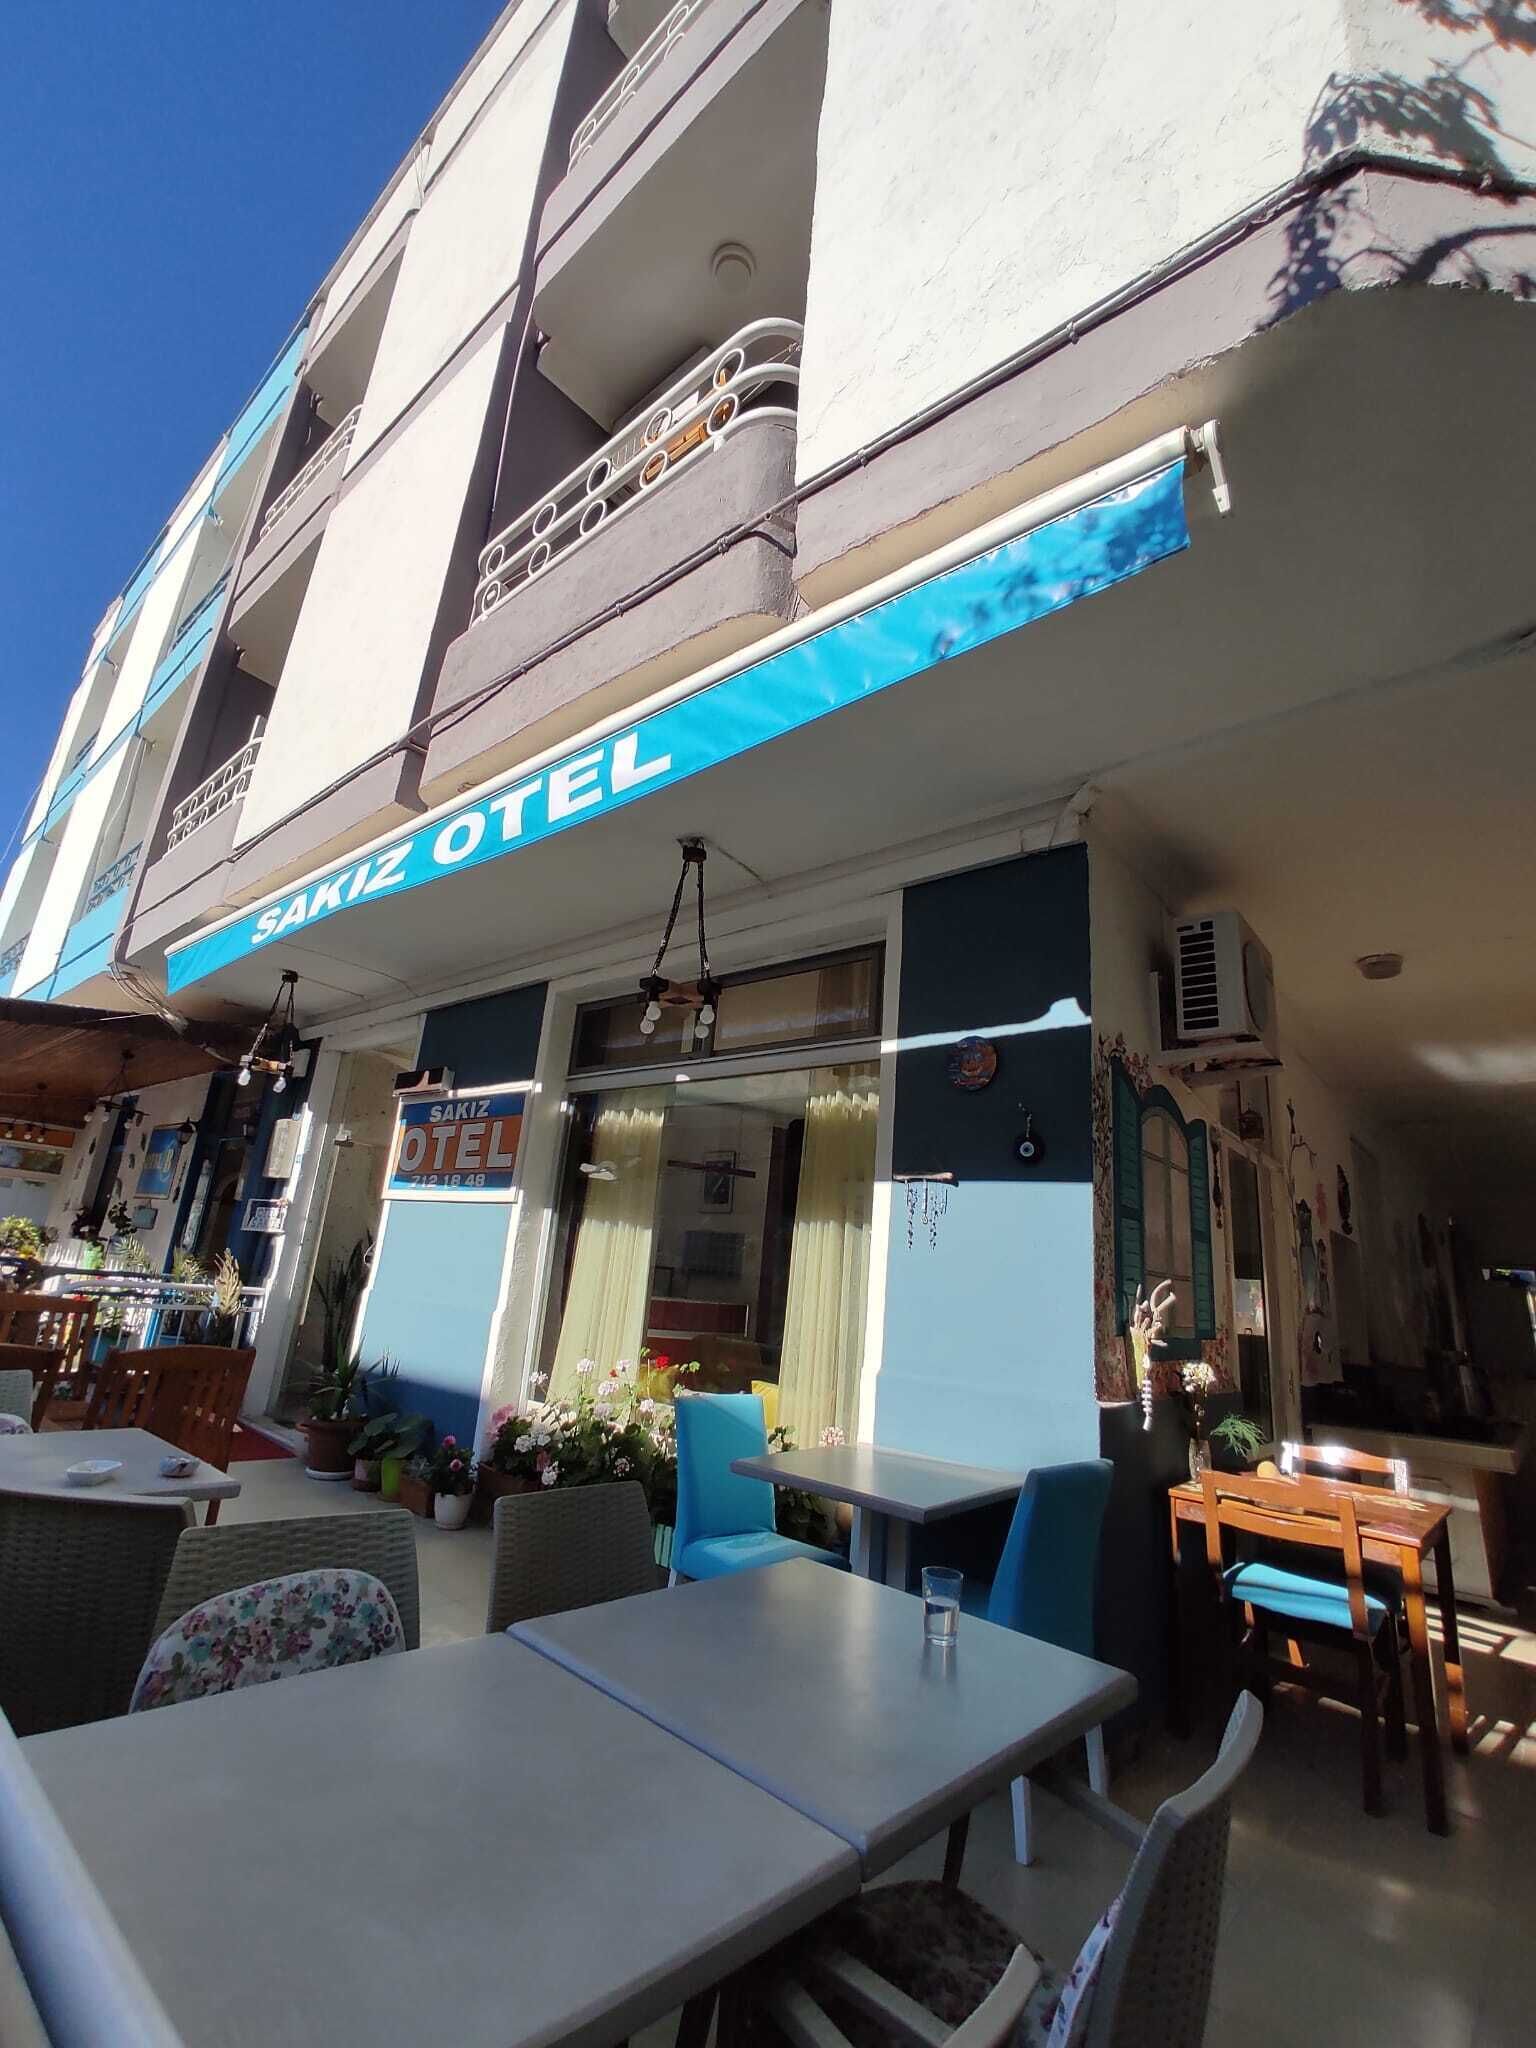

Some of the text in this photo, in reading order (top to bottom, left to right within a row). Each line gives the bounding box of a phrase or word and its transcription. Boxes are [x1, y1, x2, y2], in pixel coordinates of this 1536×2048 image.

[252, 731, 671, 944] SAKIZ OTEL
[430, 1100, 490, 1122] SAKIZ
[400, 1120, 512, 1171] OTEL
[443, 1174, 461, 1188] 18
[464, 1173, 486, 1187] 48
